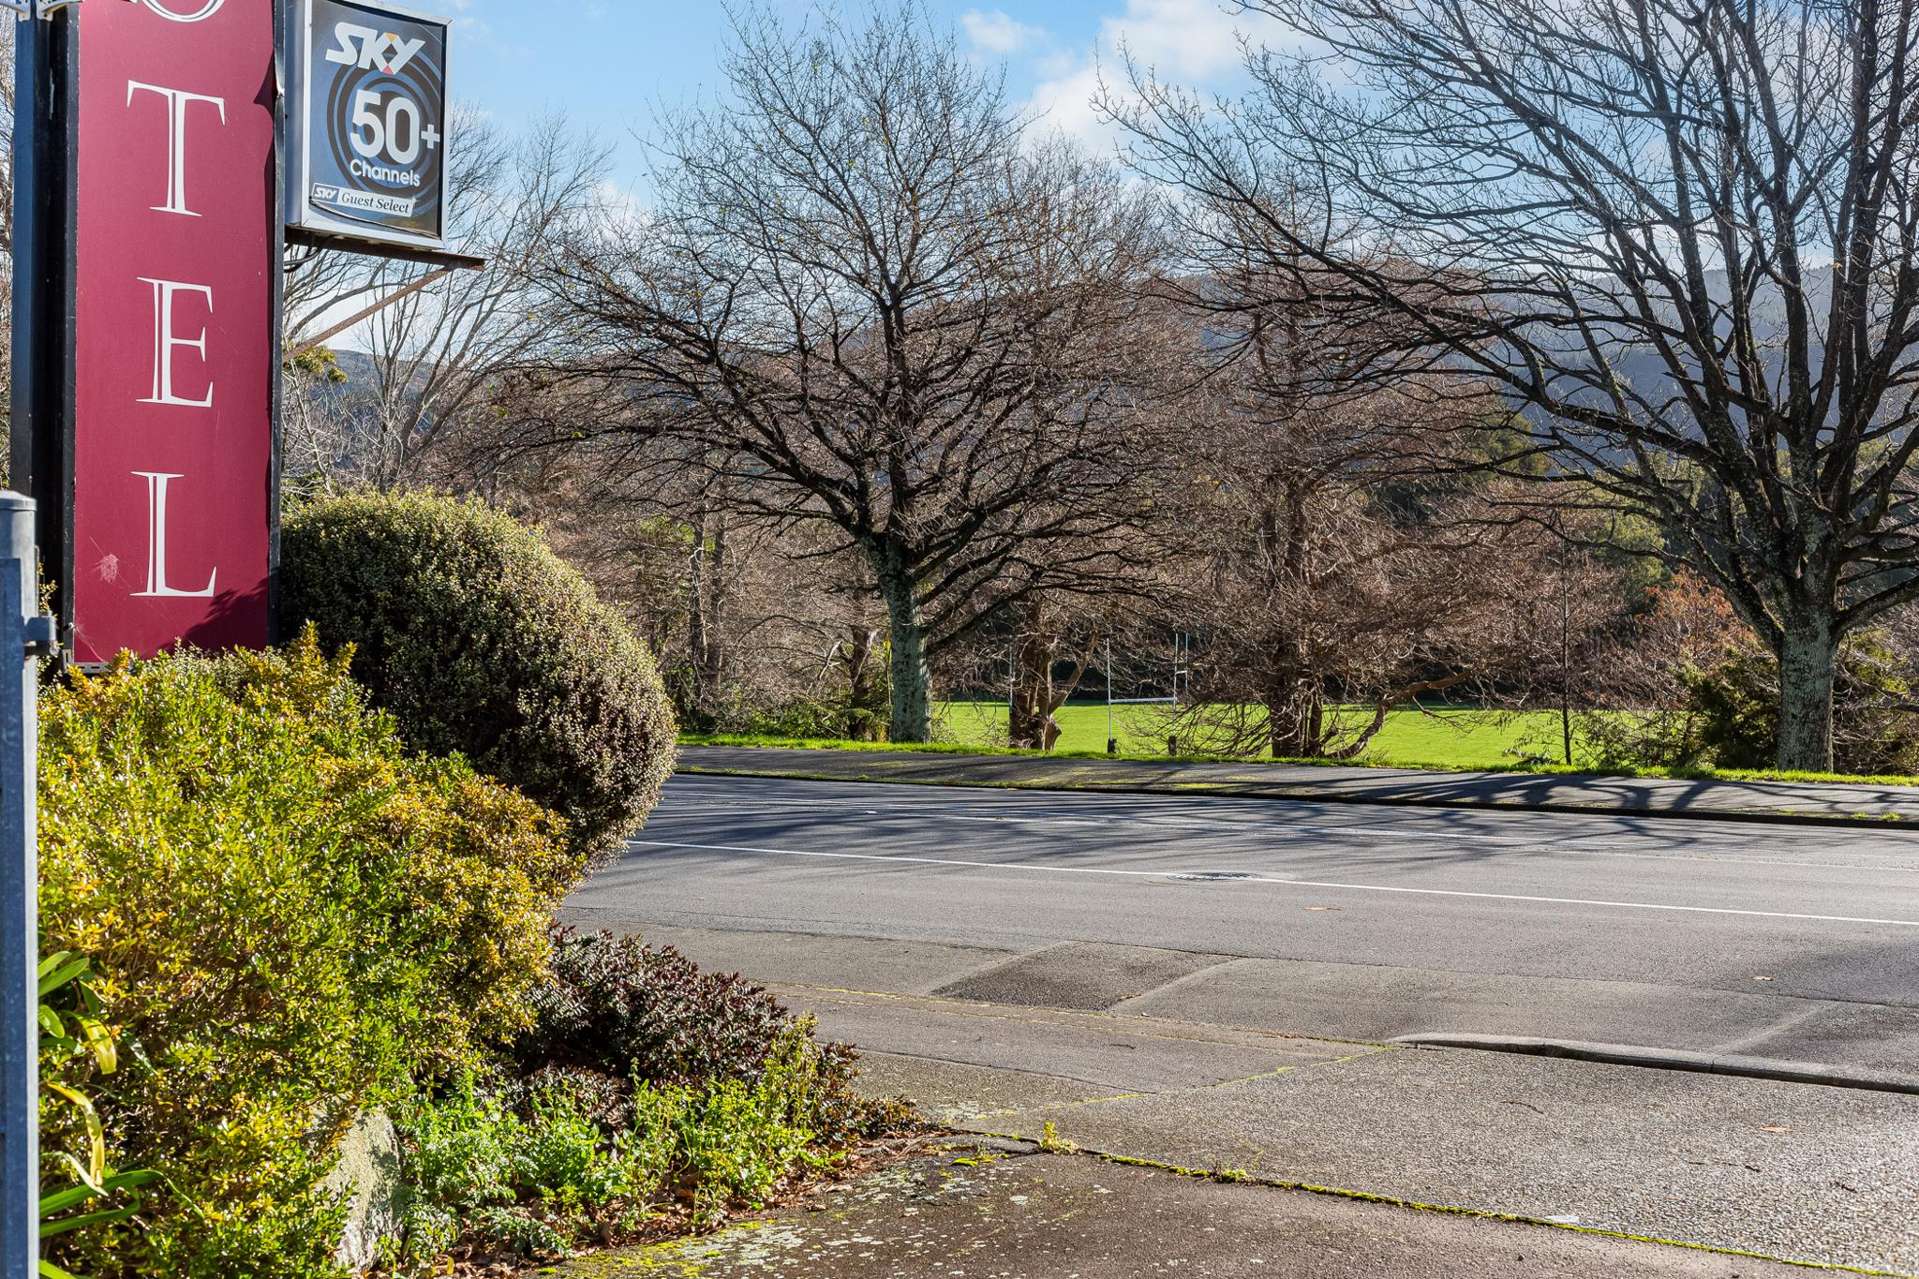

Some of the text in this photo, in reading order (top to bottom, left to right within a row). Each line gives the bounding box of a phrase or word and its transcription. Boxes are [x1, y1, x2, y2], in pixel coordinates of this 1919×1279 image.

[325, 22, 426, 75] SKY
[350, 89, 440, 164] 50+
[350, 158, 420, 187] Channels
[341, 192, 374, 208] Guest
[376, 199, 409, 213] Select
[127, 0, 225, 597] TEL
